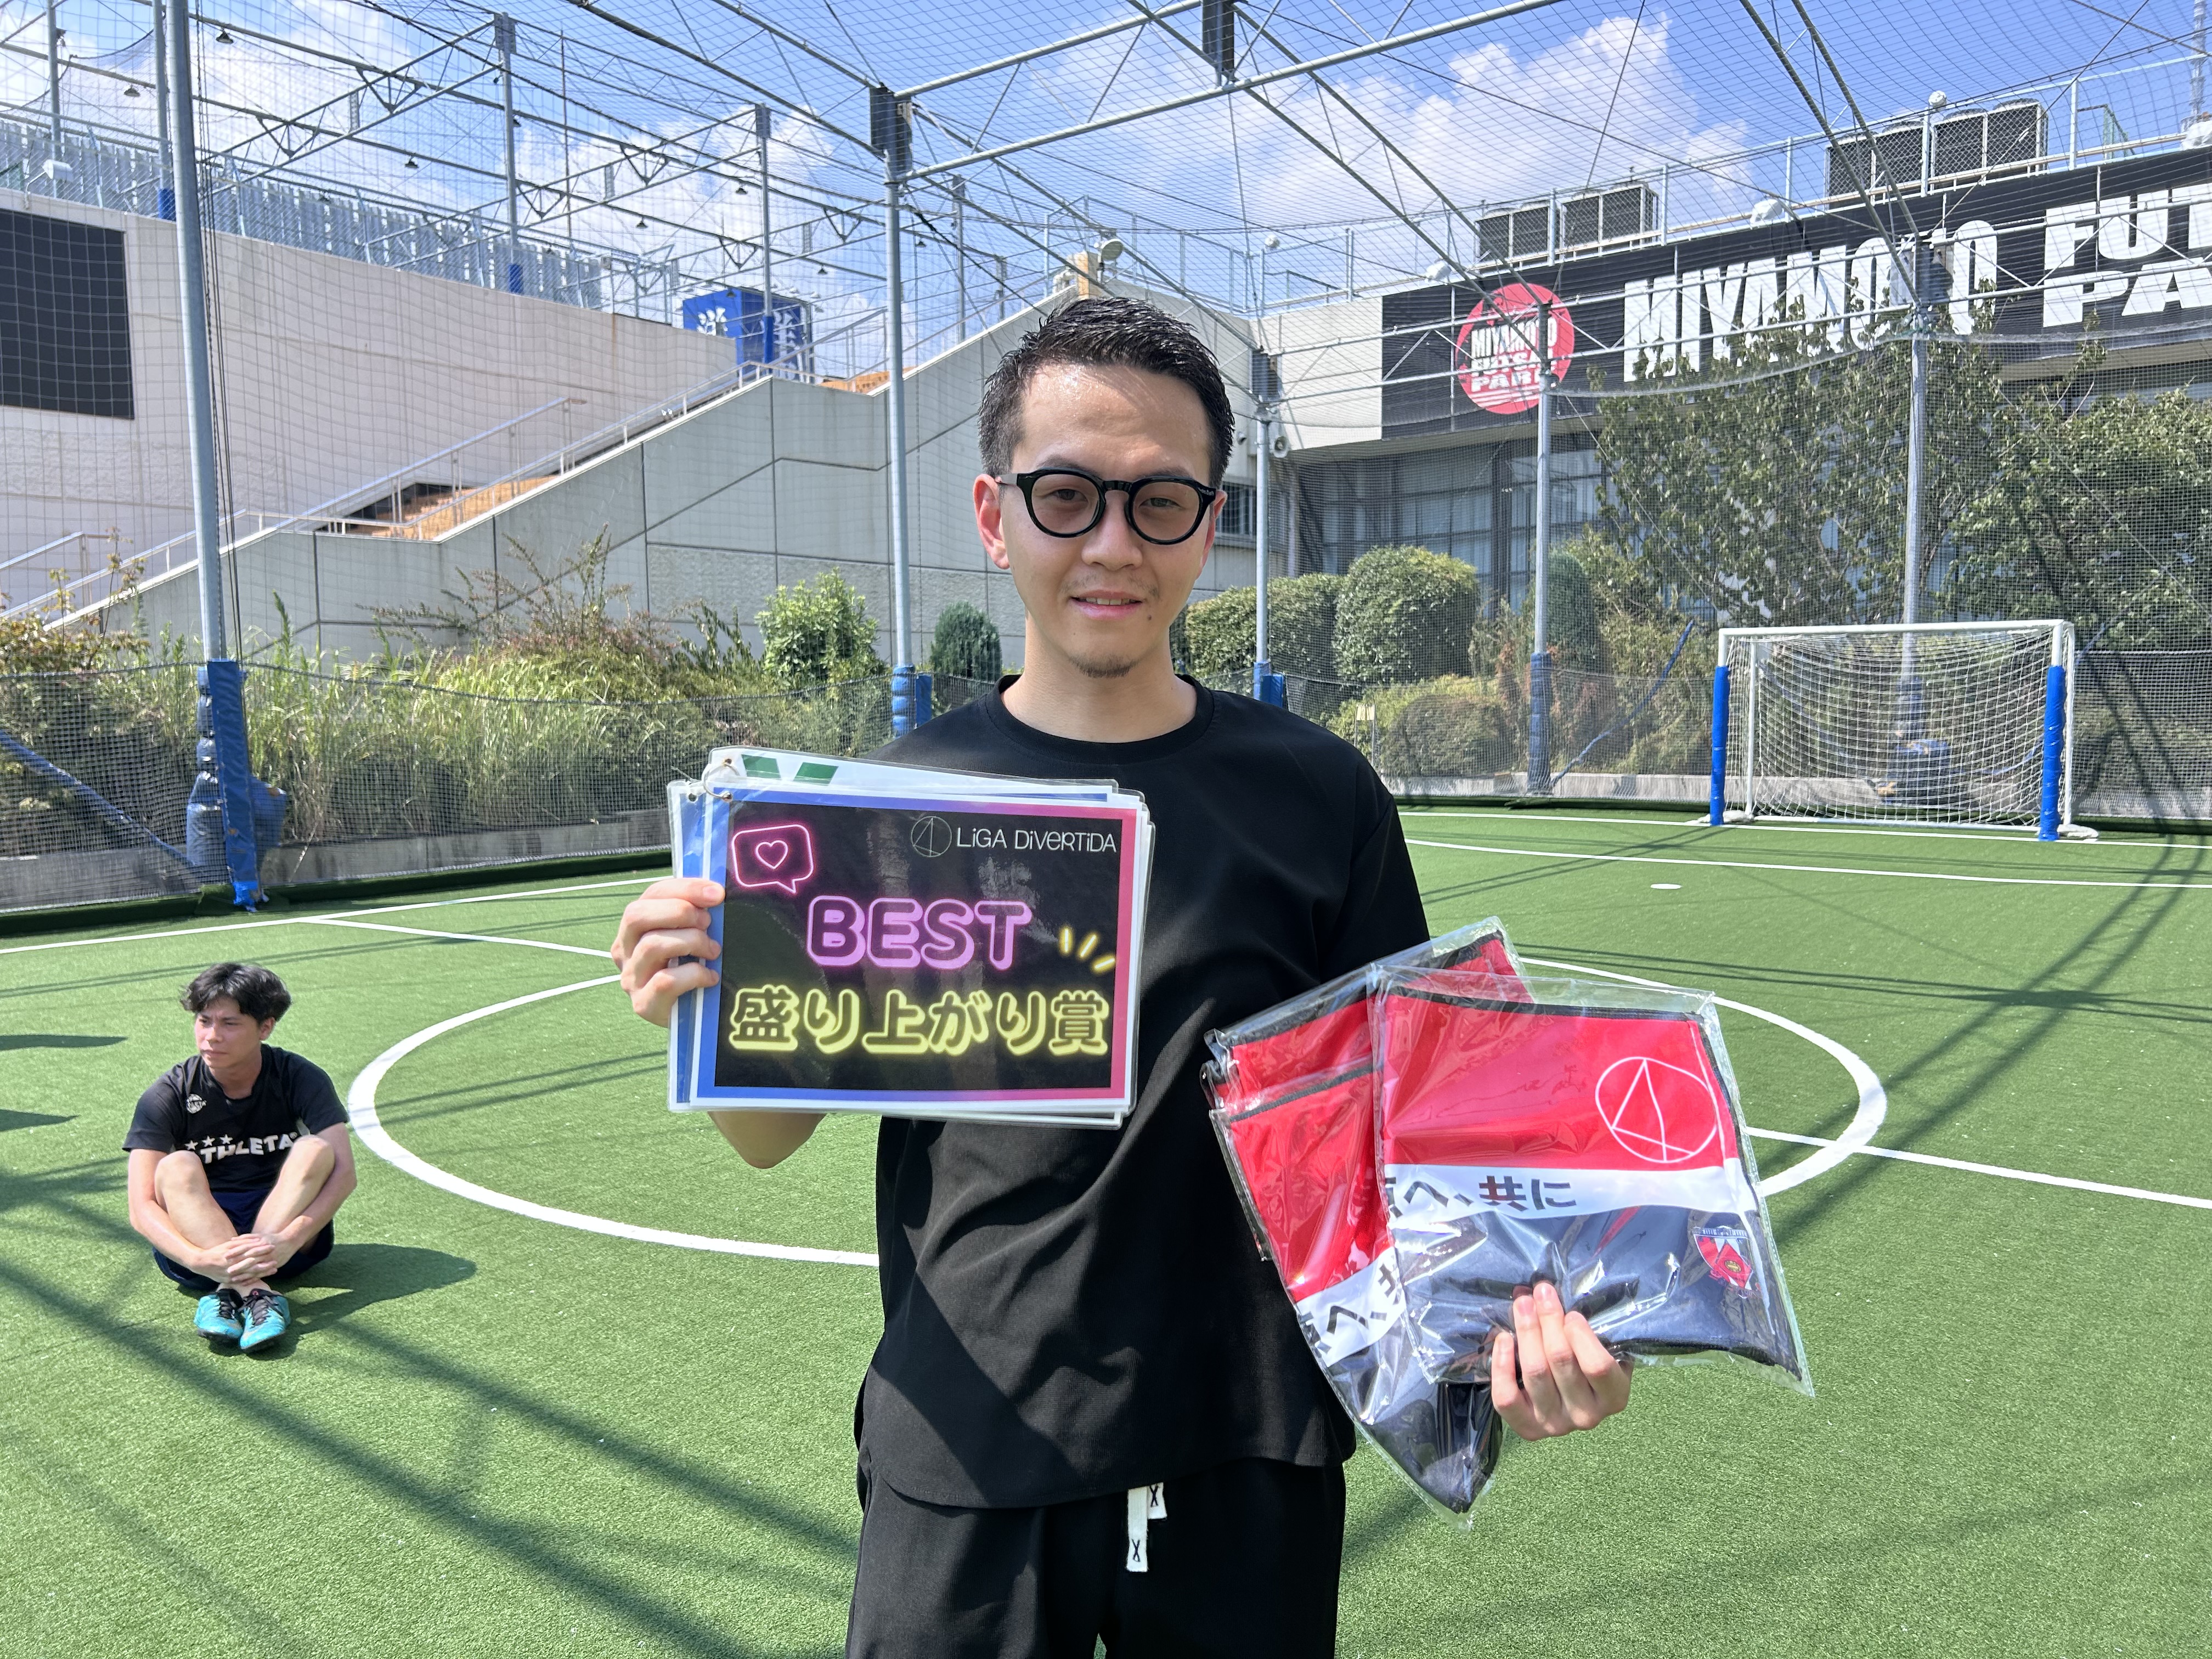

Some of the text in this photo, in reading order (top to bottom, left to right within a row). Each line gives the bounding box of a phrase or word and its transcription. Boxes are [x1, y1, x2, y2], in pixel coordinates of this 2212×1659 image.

[1624, 220, 1998, 381] MIYAMOO
[1471, 317, 1558, 358] MIYAMOO
[807, 895, 1032, 970] BEST
[729, 985, 1109, 1057] 盛り上がり賞
